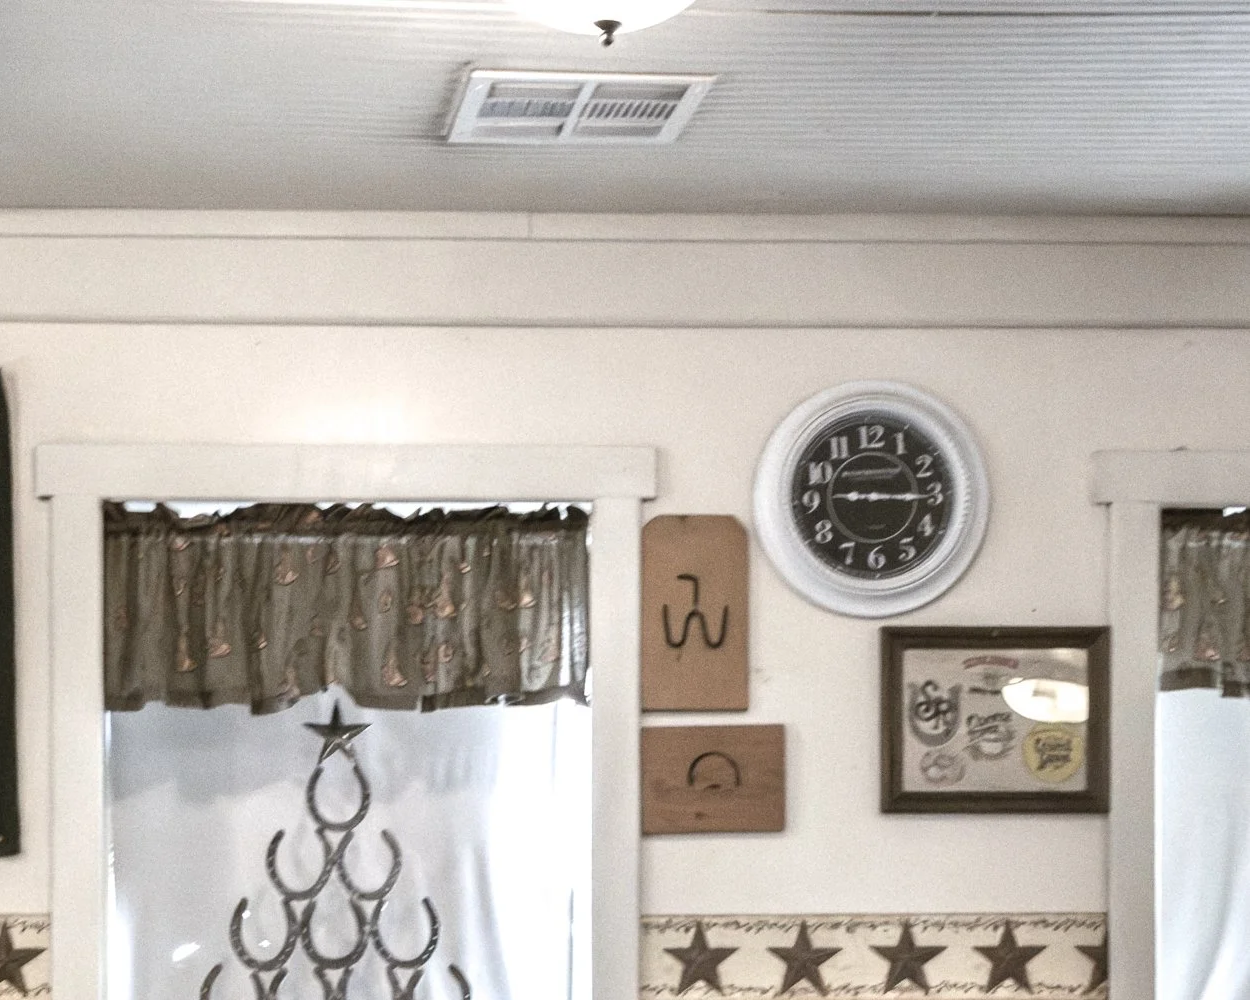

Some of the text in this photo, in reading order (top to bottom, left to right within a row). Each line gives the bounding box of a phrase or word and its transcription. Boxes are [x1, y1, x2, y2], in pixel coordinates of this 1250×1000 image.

[830, 436, 848, 460] 11
[858, 424, 885, 449] 12
[894, 432, 907, 455] 1
[808, 461, 833, 486] 10
[915, 454, 933, 478] 2
[802, 490, 821, 515] 9
[926, 481, 944, 506] 3
[814, 519, 834, 544] 8
[916, 513, 935, 537] 4
[838, 541, 856, 566] 7
[867, 545, 886, 570] 6
[898, 536, 917, 561] 5
